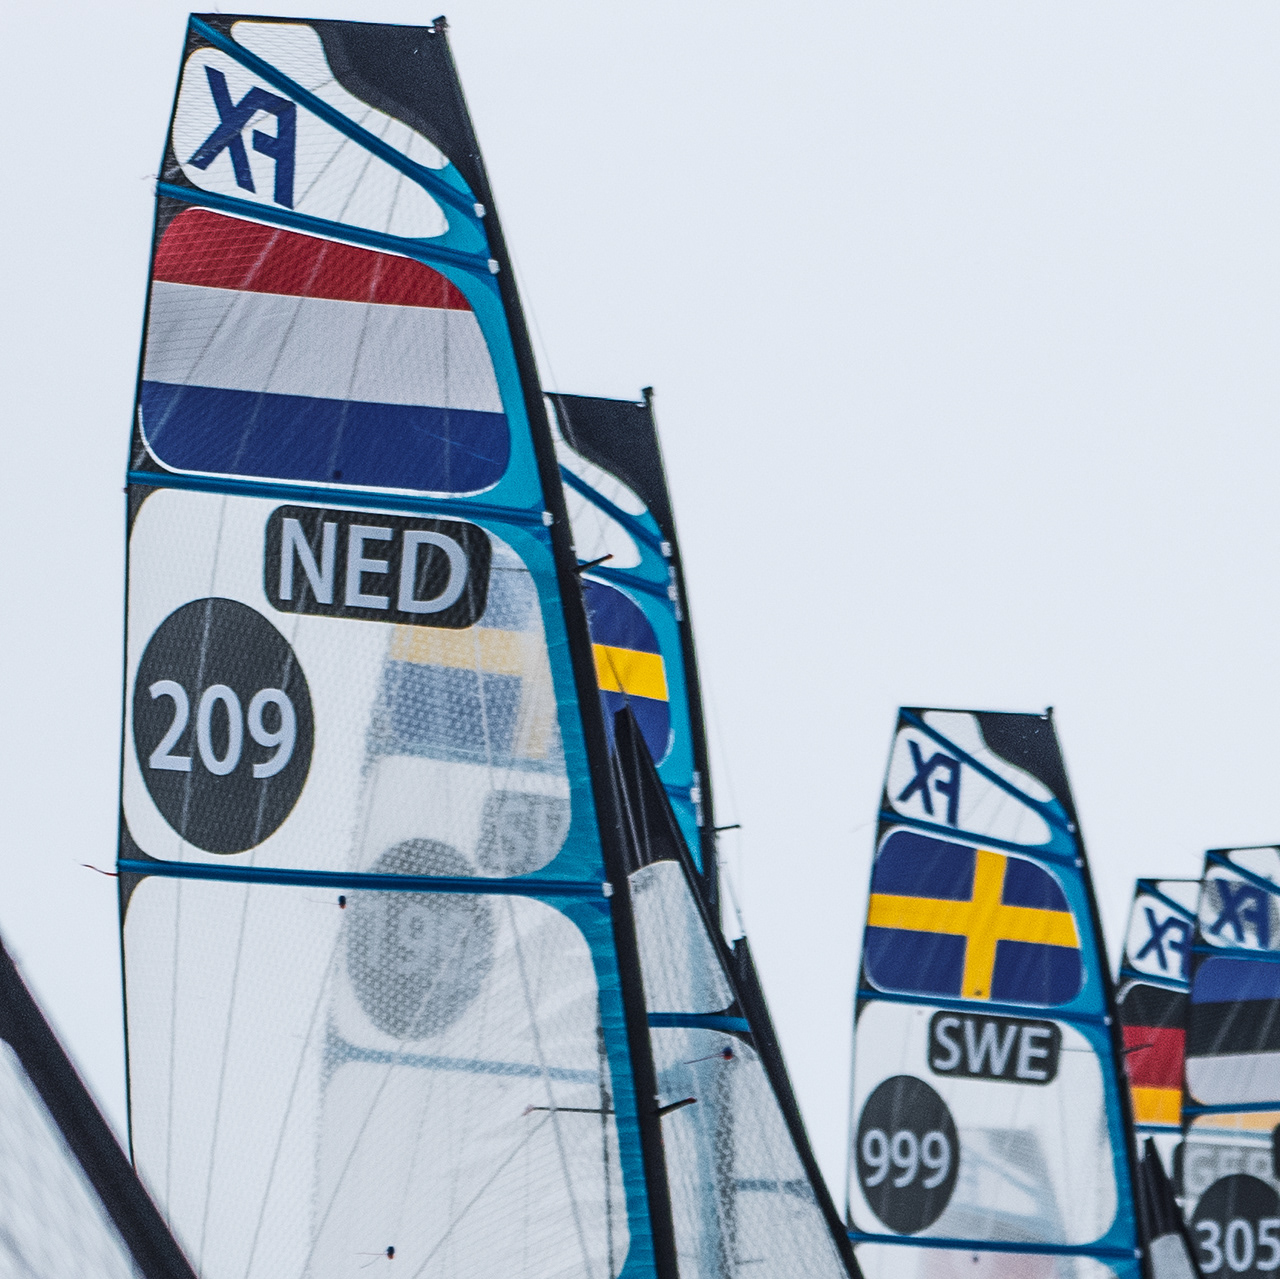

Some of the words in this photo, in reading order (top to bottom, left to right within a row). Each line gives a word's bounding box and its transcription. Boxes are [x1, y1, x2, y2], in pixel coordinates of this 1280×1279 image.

[279, 517, 468, 616] NED
[149, 680, 297, 780] 209
[933, 1017, 1050, 1080] SWE
[862, 1127, 951, 1189] 999
